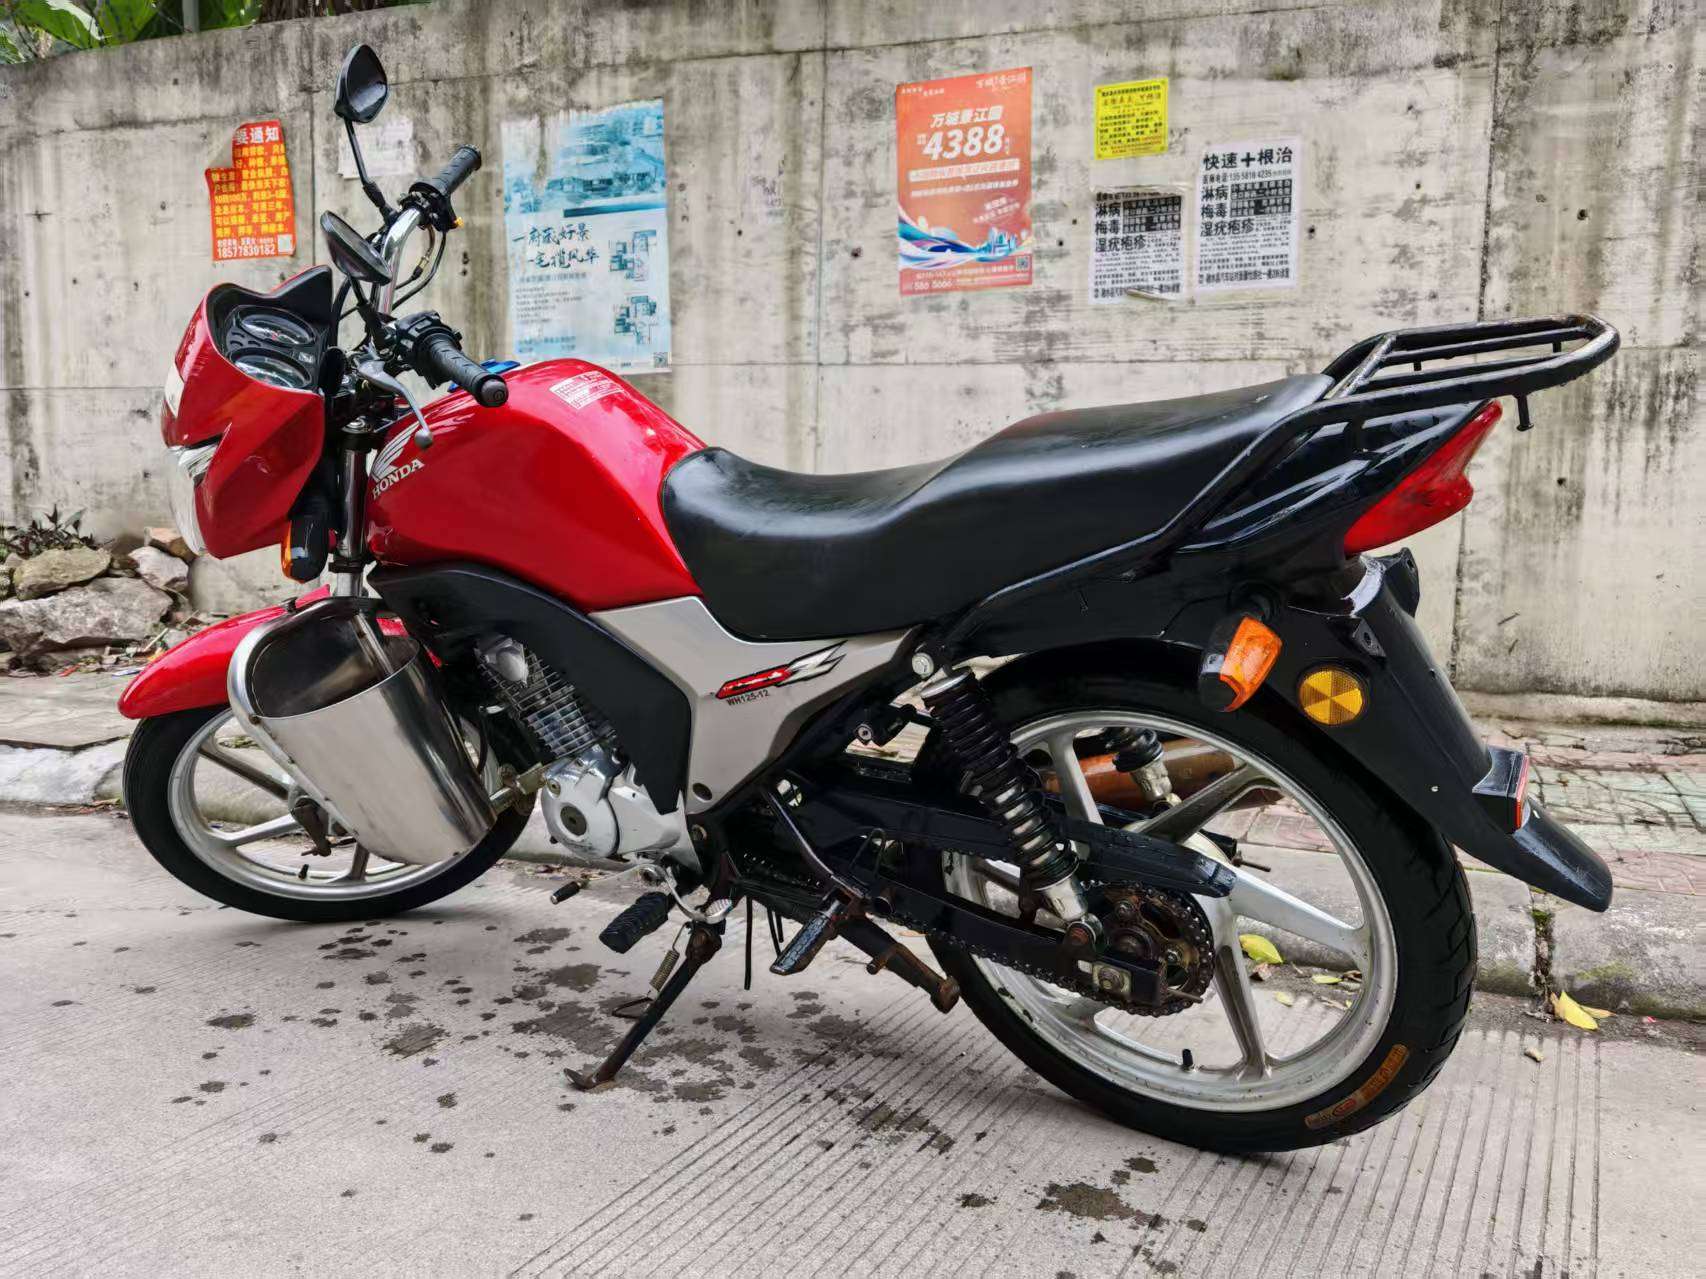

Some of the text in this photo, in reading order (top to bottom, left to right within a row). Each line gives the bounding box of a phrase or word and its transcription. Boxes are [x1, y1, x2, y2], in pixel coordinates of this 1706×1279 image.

[922, 124, 1005, 160] 4388
[1201, 184, 1229, 201] 淋病
[1201, 202, 1228, 220] 梅毒
[371, 458, 425, 500] HONDA
